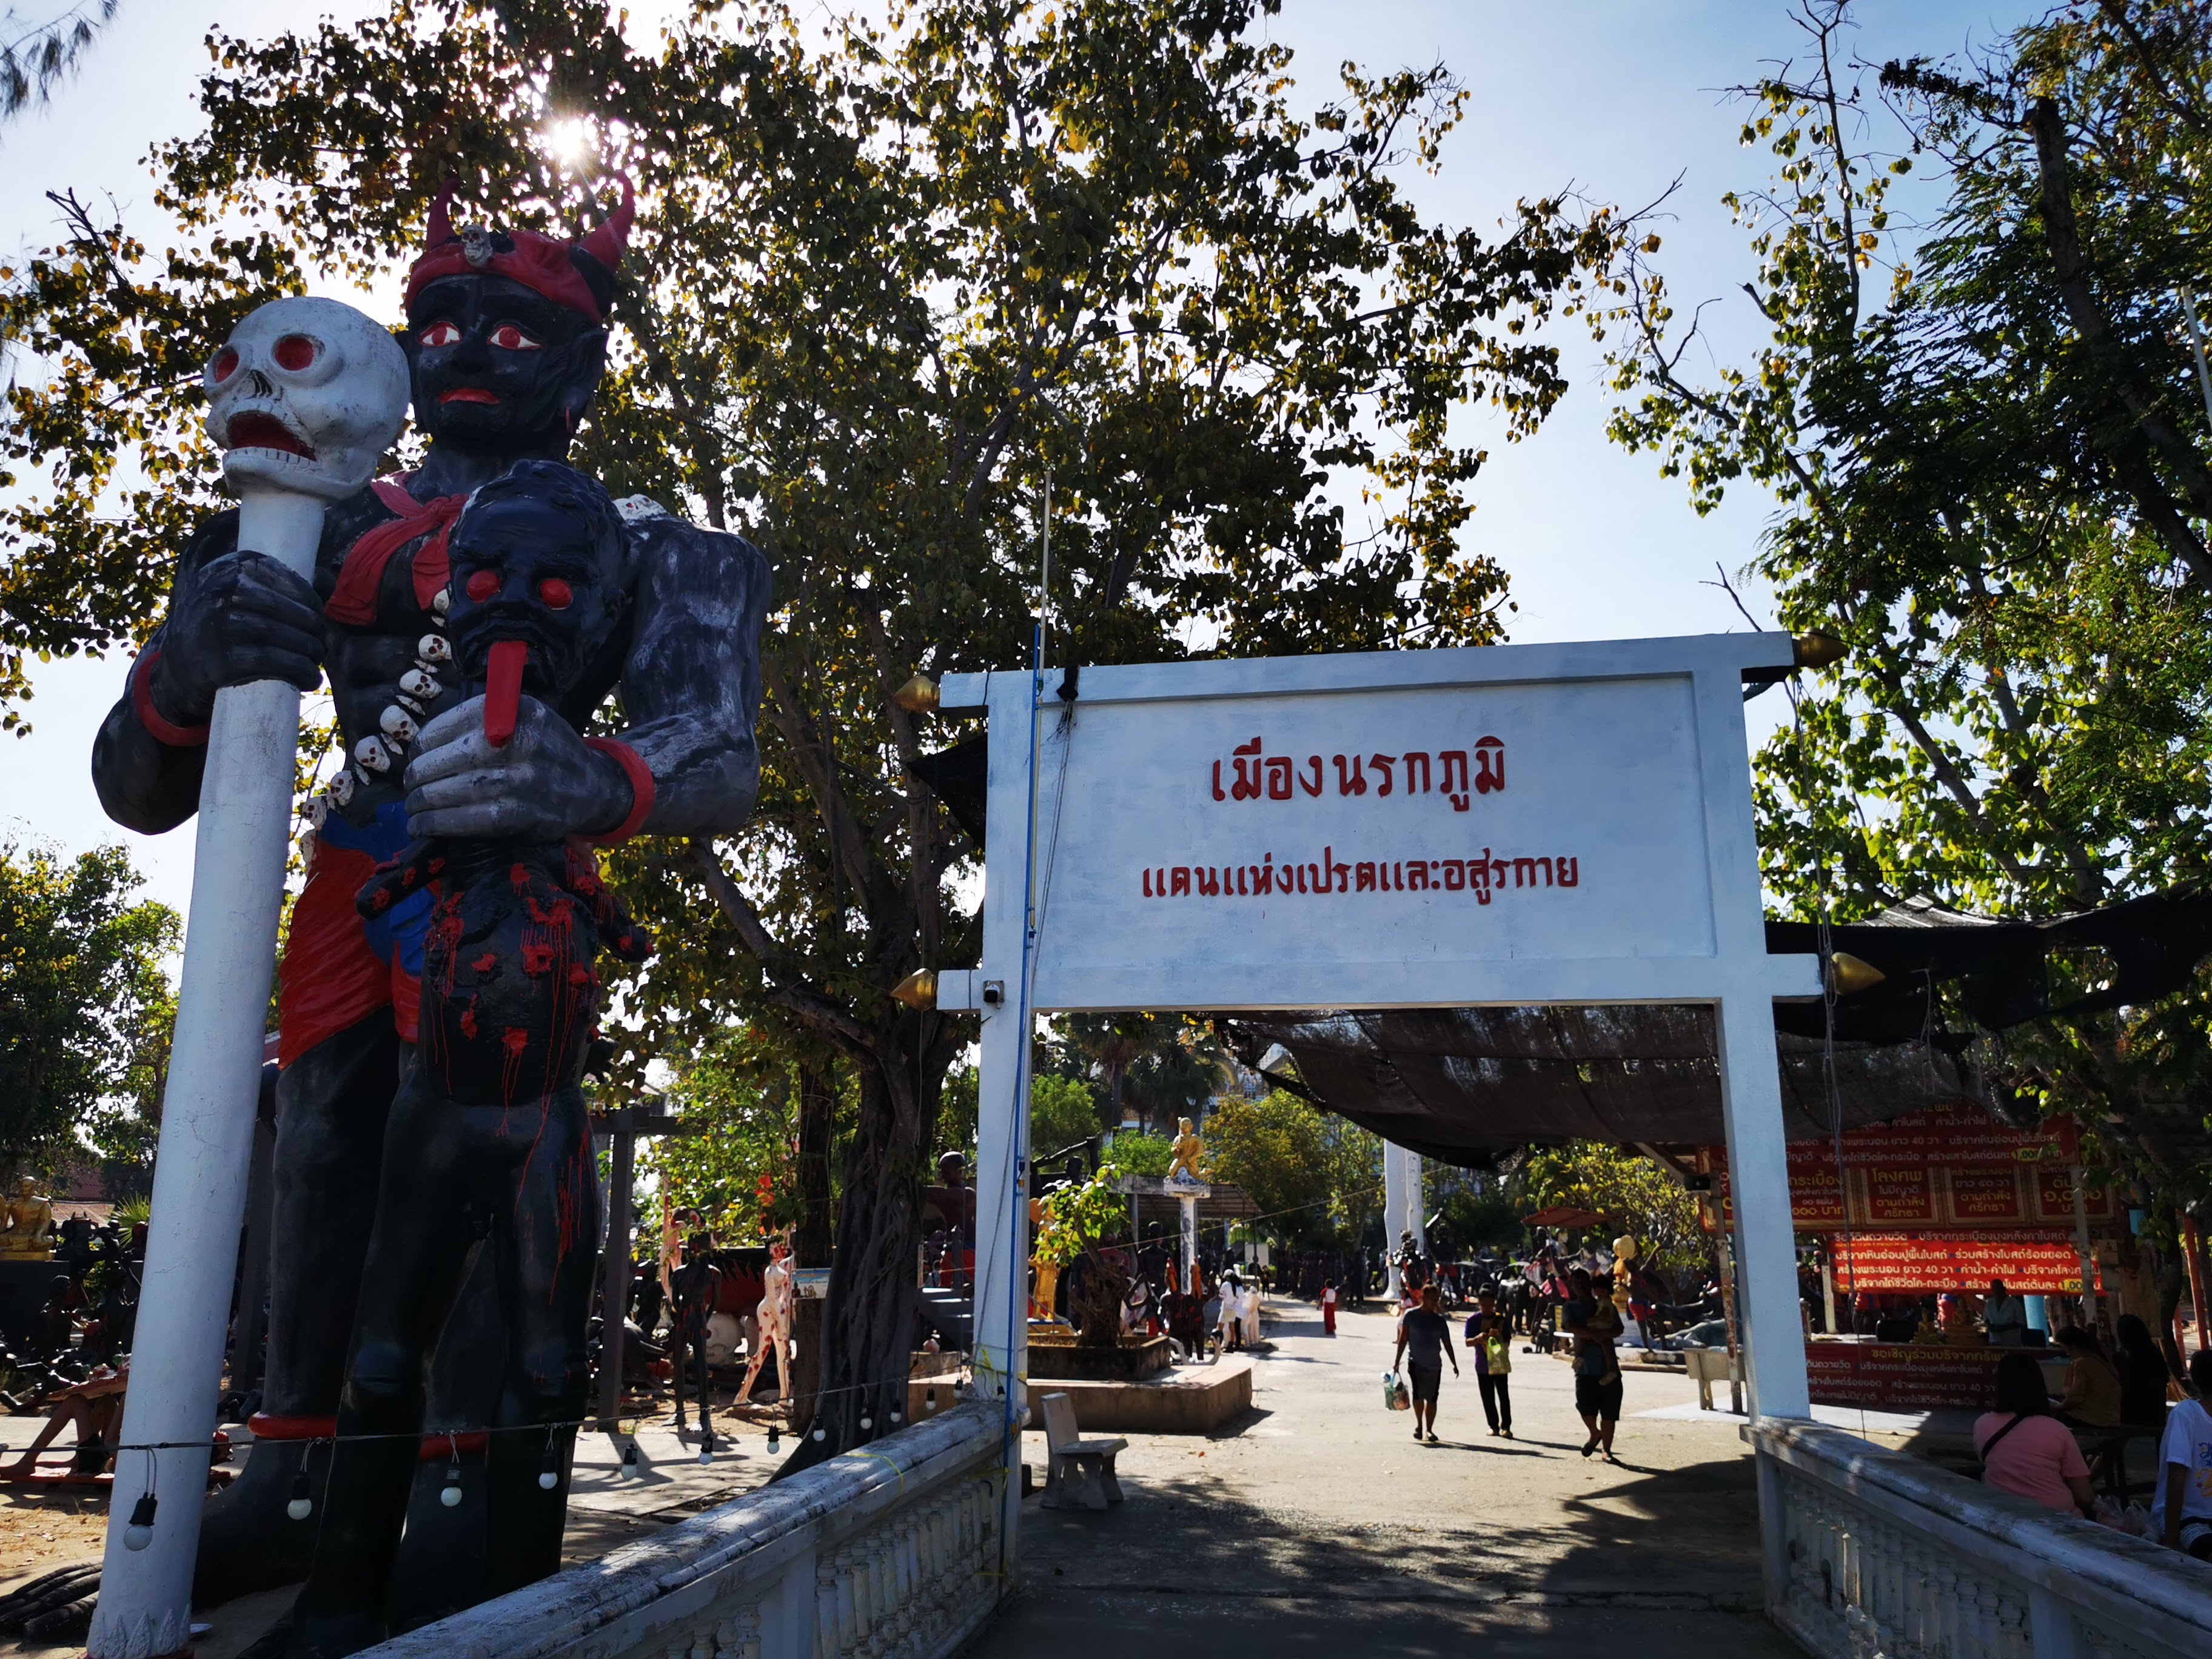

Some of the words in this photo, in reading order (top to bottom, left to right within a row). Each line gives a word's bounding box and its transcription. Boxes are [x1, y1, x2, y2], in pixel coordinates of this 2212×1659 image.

[1213, 736, 1505, 811] เมืองนรกภูมิ
[1143, 846, 1578, 905] แดนแห่งเปรตและอสูรกาย
[1872, 1167, 1922, 1183] โลงศพ
[1903, 1265, 1922, 1274] ยาว
[1924, 1265, 1938, 1274] 40
[1940, 1265, 1953, 1274] วา
